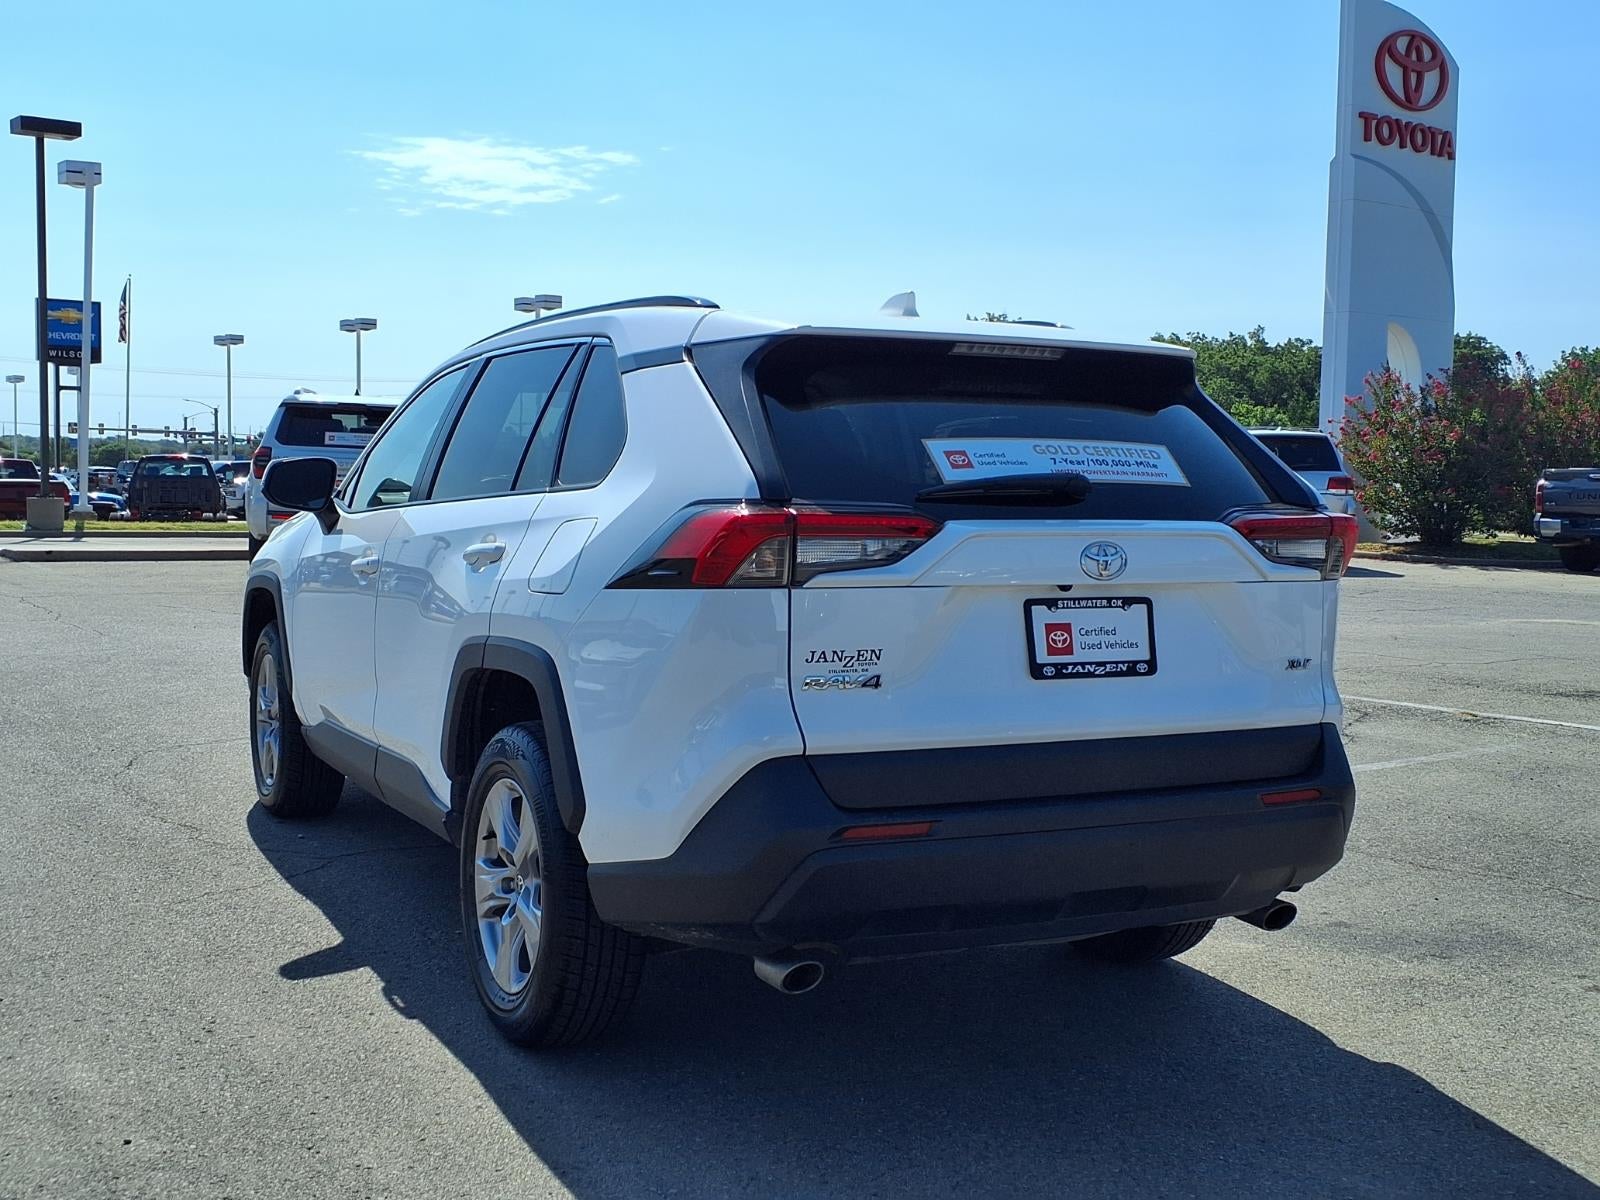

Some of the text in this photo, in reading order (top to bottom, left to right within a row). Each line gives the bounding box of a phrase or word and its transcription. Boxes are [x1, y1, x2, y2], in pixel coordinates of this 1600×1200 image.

[1358, 111, 1456, 160] TOYOTA
[48, 349, 83, 358] WILSO
[973, 451, 1006, 459] Certified
[1032, 444, 1161, 460] GOLD CERTIFIED
[1049, 457, 1159, 470] 7-Year/100,000-Mile
[1567, 491, 1600, 501] TUN
[1078, 627, 1117, 637] Certified
[1080, 639, 1139, 650] Used Vehicles
[805, 649, 883, 668] JANZEN
[1062, 663, 1129, 675] JANZEN
[802, 674, 882, 690] RAV4
